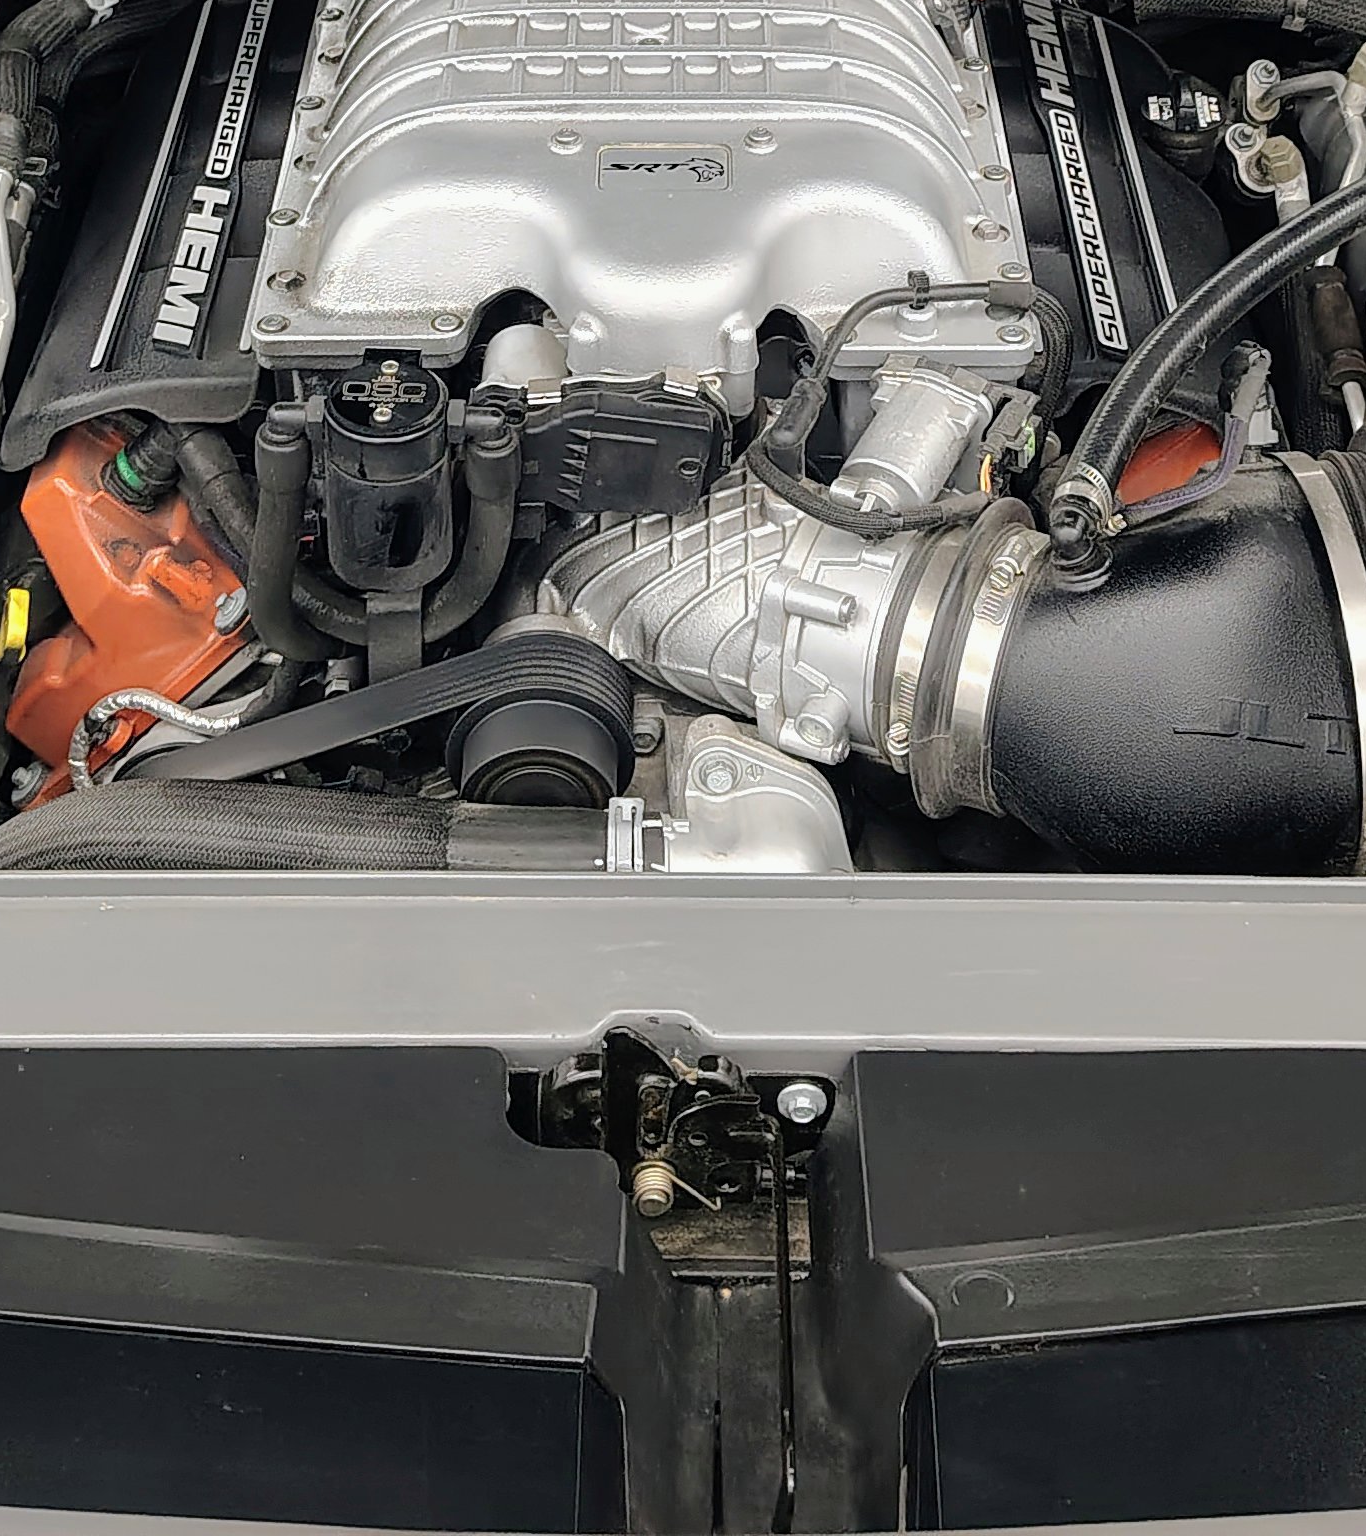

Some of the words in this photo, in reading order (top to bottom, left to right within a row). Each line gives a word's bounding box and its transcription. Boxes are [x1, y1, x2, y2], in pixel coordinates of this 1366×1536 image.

[152, 185, 232, 348] HEMI
[1050, 108, 1128, 351] SUPERCHARGED
[342, 381, 427, 398] OSC
